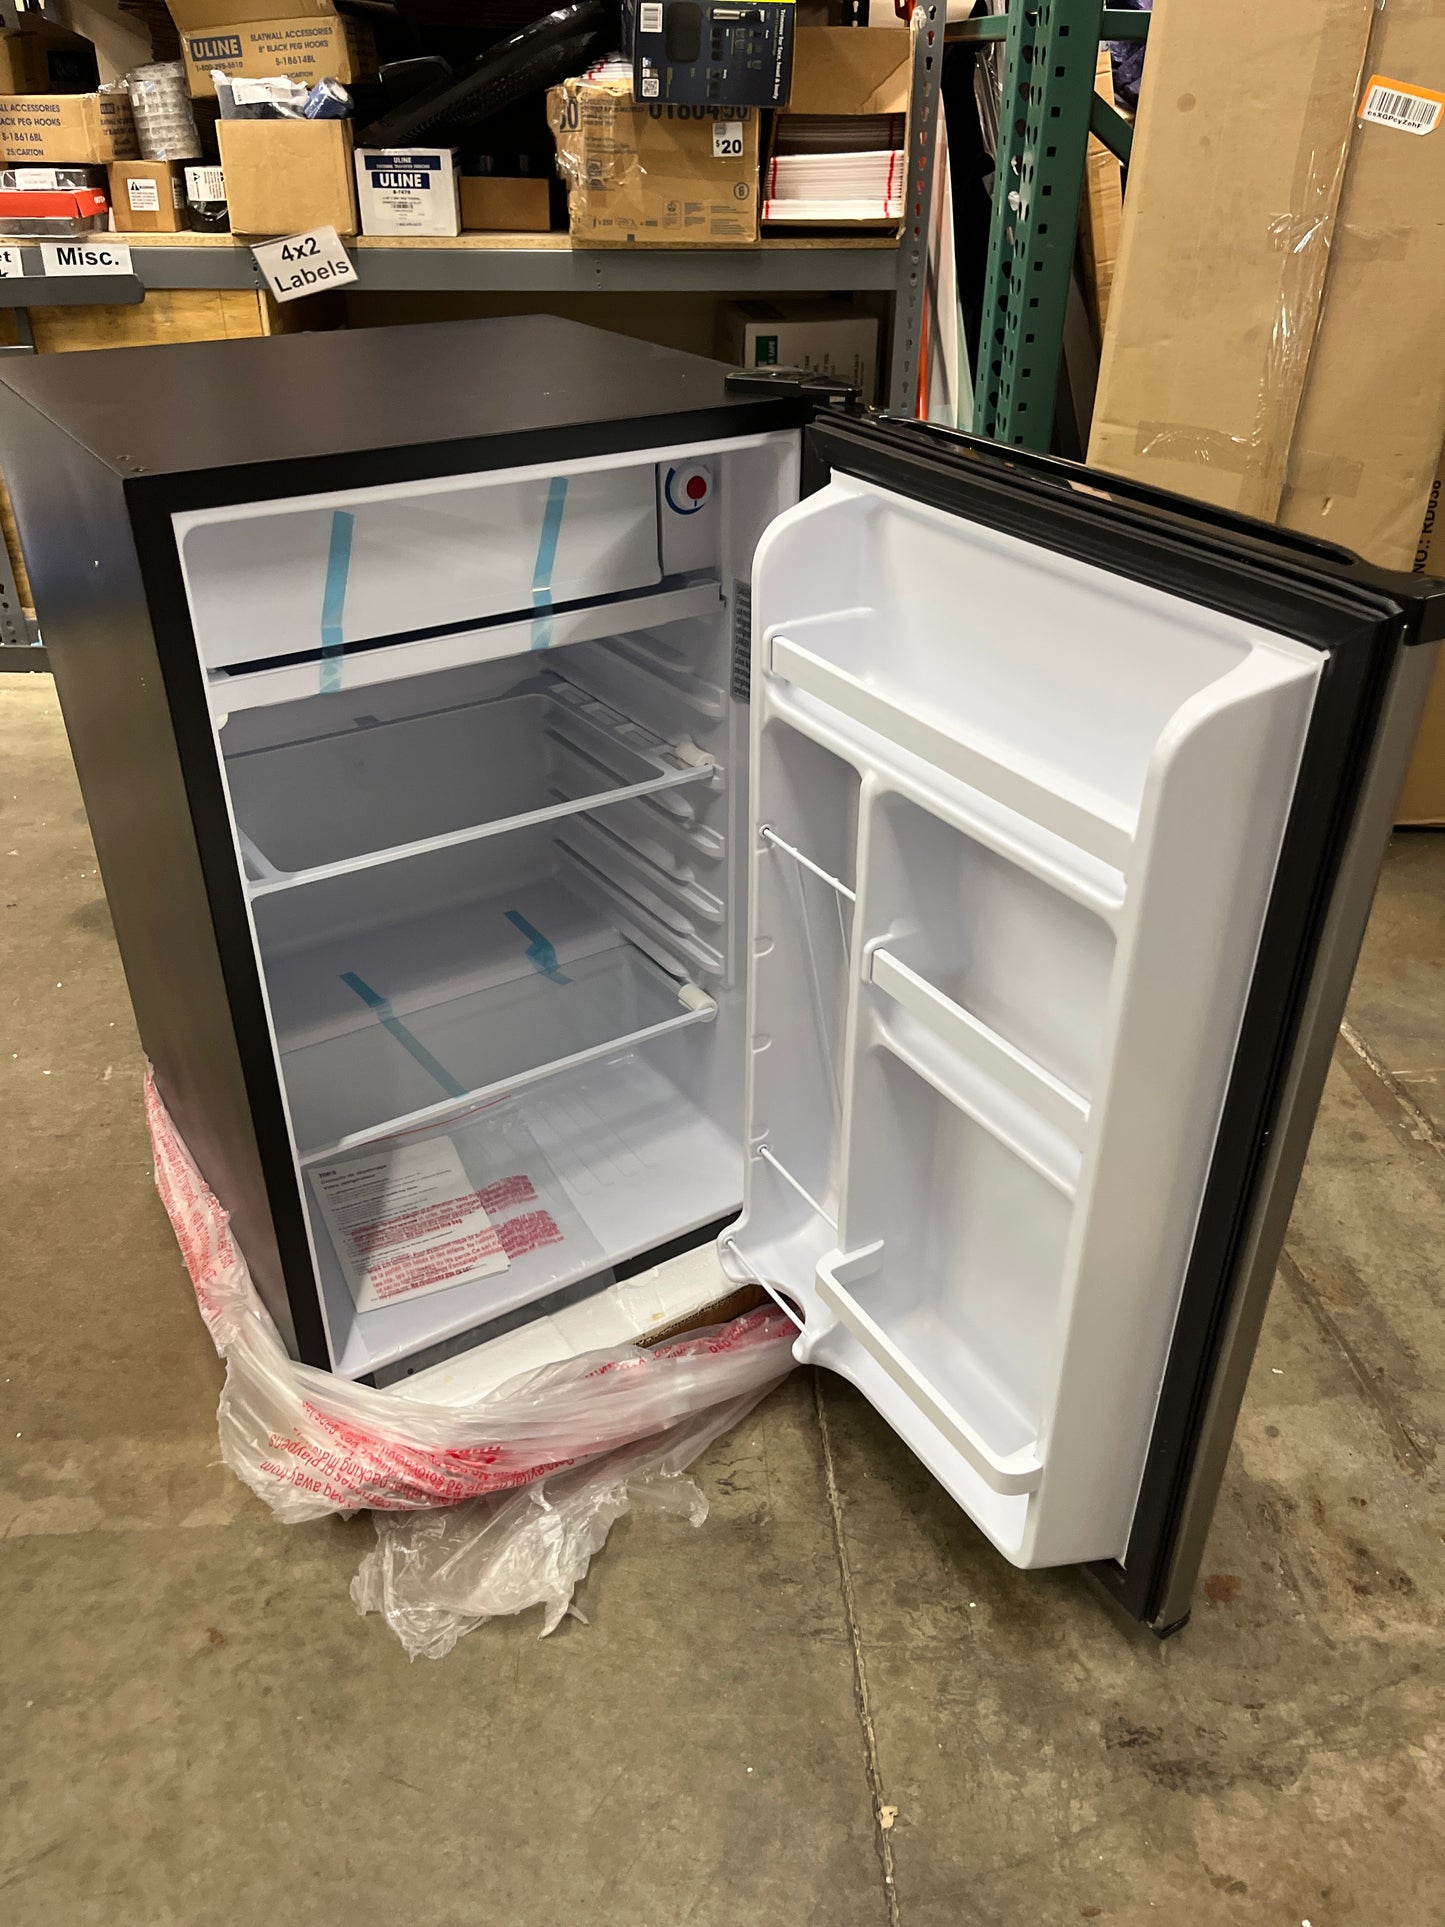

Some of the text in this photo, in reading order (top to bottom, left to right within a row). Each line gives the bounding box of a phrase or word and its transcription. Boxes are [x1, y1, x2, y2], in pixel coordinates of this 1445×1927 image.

[250, 26, 333, 42] SLATWALL ACCESSORIES
[193, 38, 240, 58] ULINE
[267, 44, 288, 53] BLACK
[290, 42, 302, 50] PEG
[304, 40, 329, 49] HOOKS
[10, 104, 60, 113] ACCESSORIES
[18, 118, 32, 126] PEG
[34, 118, 62, 127] HOOKS
[393, 156, 412, 164] ULINE
[380, 172, 422, 188] ULINE
[56, 247, 120, 266] Misc.
[281, 236, 321, 262] 4x2
[274, 260, 350, 293] Labels
[266, 1433, 321, 1468] playpens
[258, 1459, 288, 1481] from
[285, 1466, 322, 1493] away
[336, 1456, 389, 1488] packing
